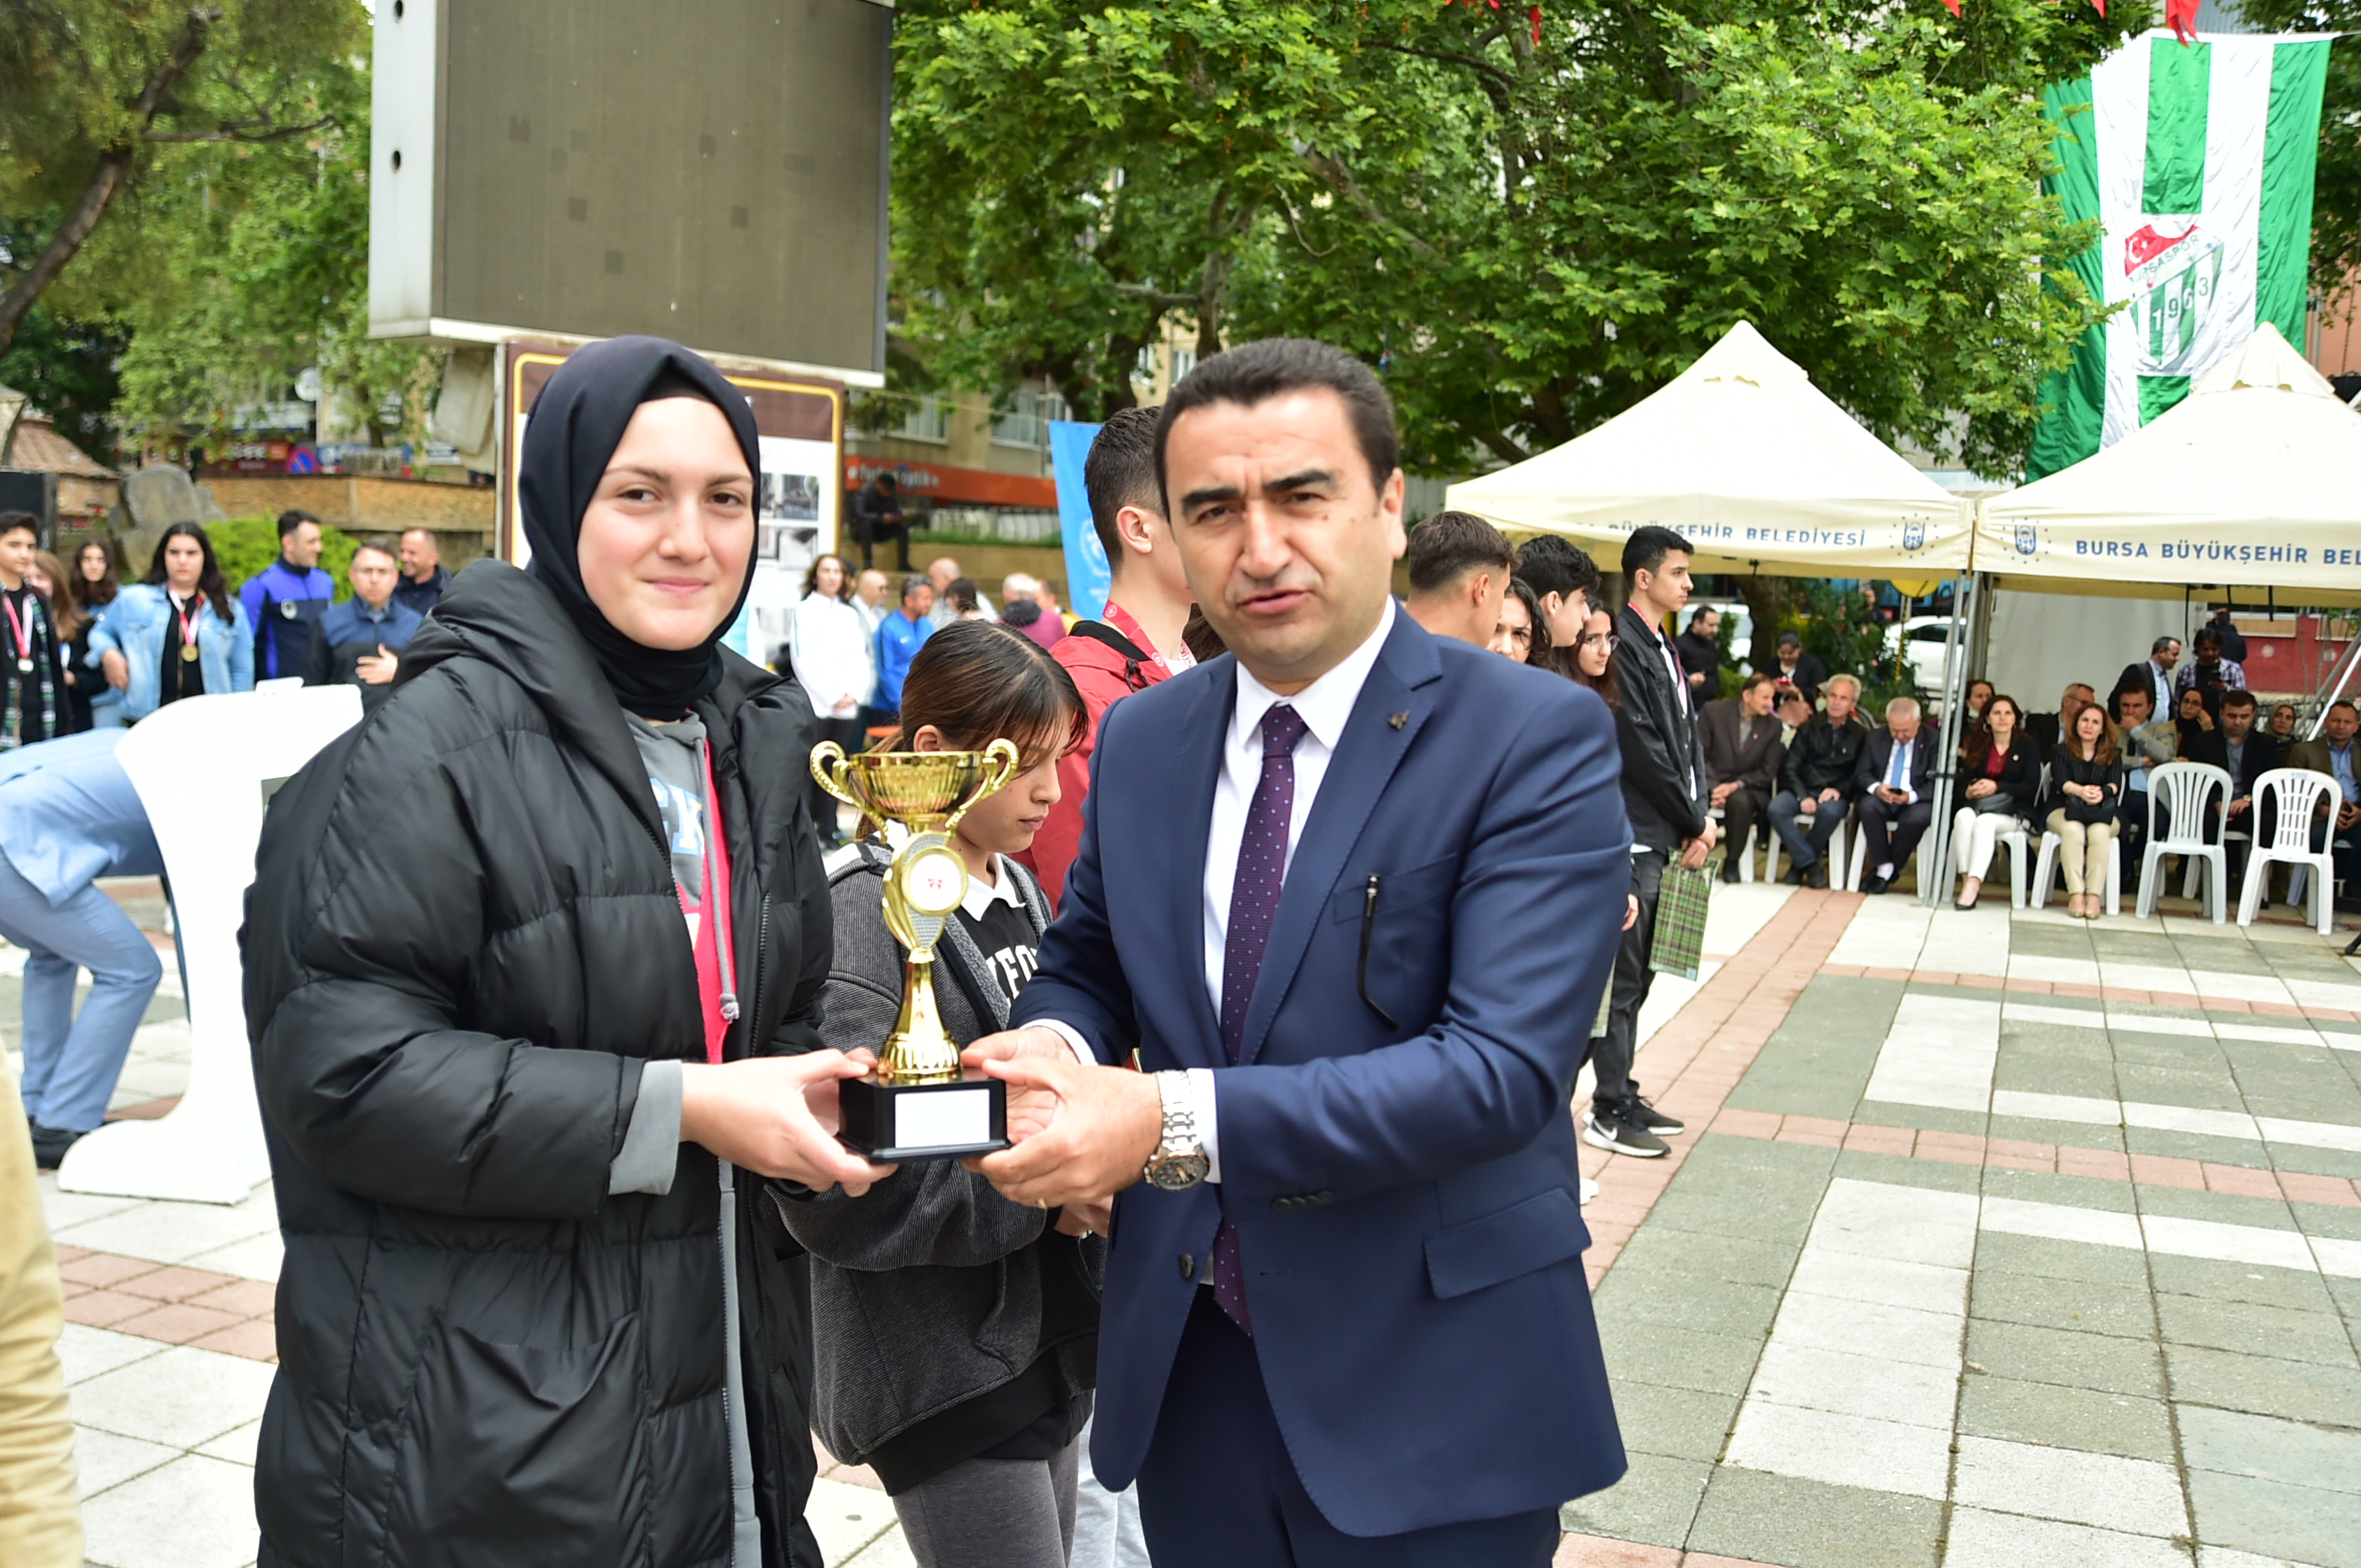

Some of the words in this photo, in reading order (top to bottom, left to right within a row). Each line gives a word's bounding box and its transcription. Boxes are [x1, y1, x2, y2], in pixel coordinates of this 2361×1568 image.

[2152, 276, 2209, 331] 1963
[1746, 527, 1866, 547] BELEDİYESİ
[2076, 540, 2149, 558] BURSA
[2161, 539, 2308, 565] BÜYÜKŞEHİR
